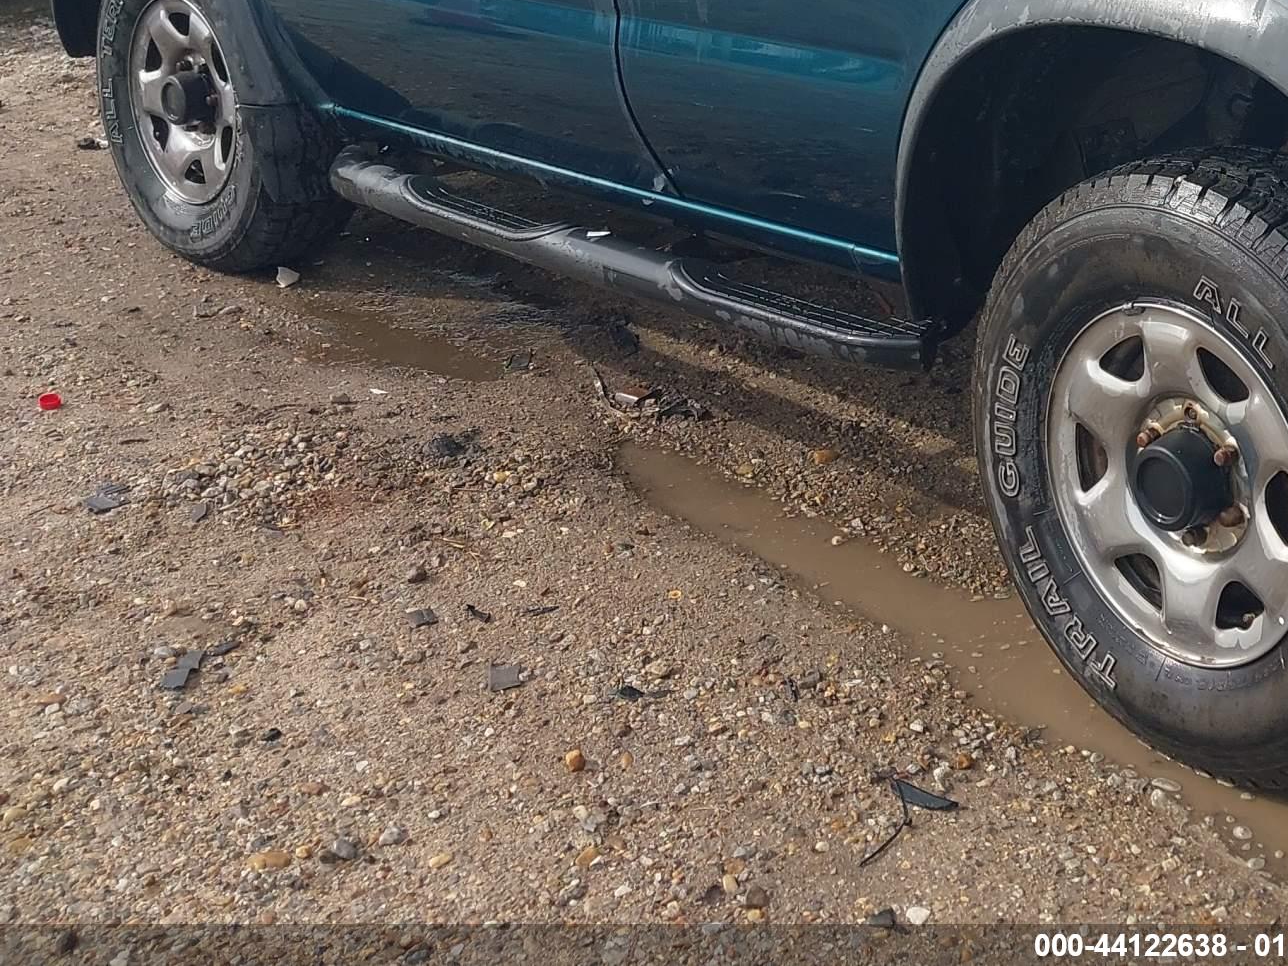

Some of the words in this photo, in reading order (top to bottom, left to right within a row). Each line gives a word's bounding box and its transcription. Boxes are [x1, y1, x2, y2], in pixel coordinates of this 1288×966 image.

[102, 78, 123, 143] ALL
[1193, 275, 1275, 369] ALL
[995, 334, 1030, 497] GUIDE
[1019, 525, 1118, 689] TRAIL
